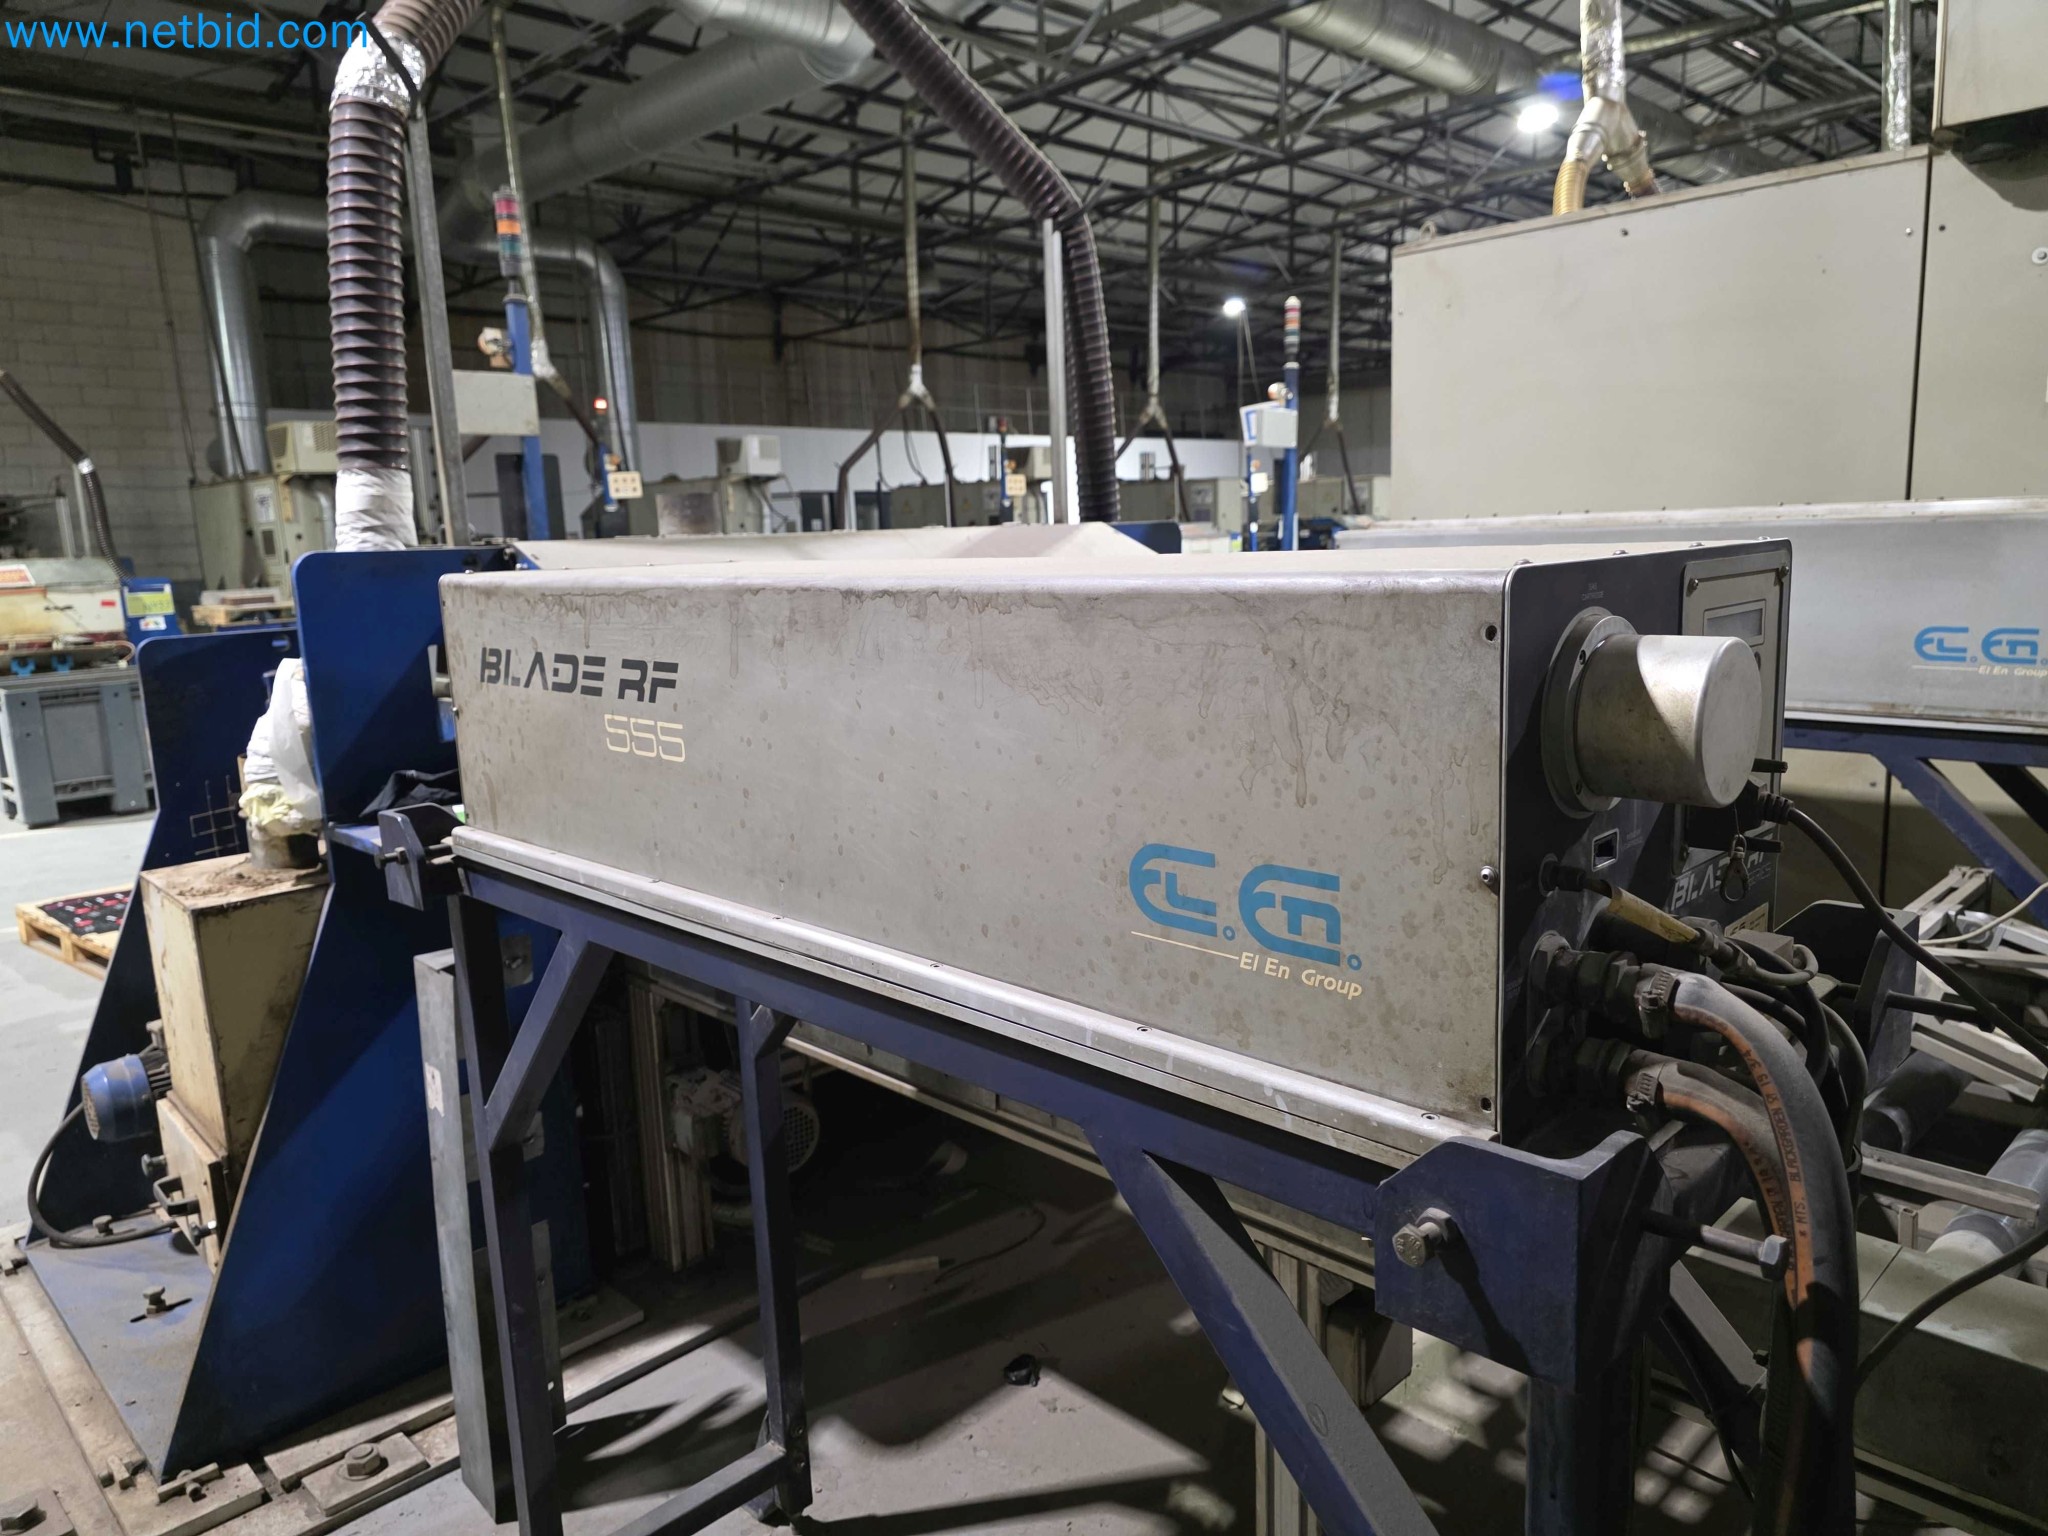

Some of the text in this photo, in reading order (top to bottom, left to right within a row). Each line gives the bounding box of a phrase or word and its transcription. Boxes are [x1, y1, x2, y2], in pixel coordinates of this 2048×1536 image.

[480, 647, 679, 704] BLADE RF
[604, 714, 685, 763] 555
[1239, 952, 1363, 1001] El En Group
[1759, 1073, 1769, 1087] 19
